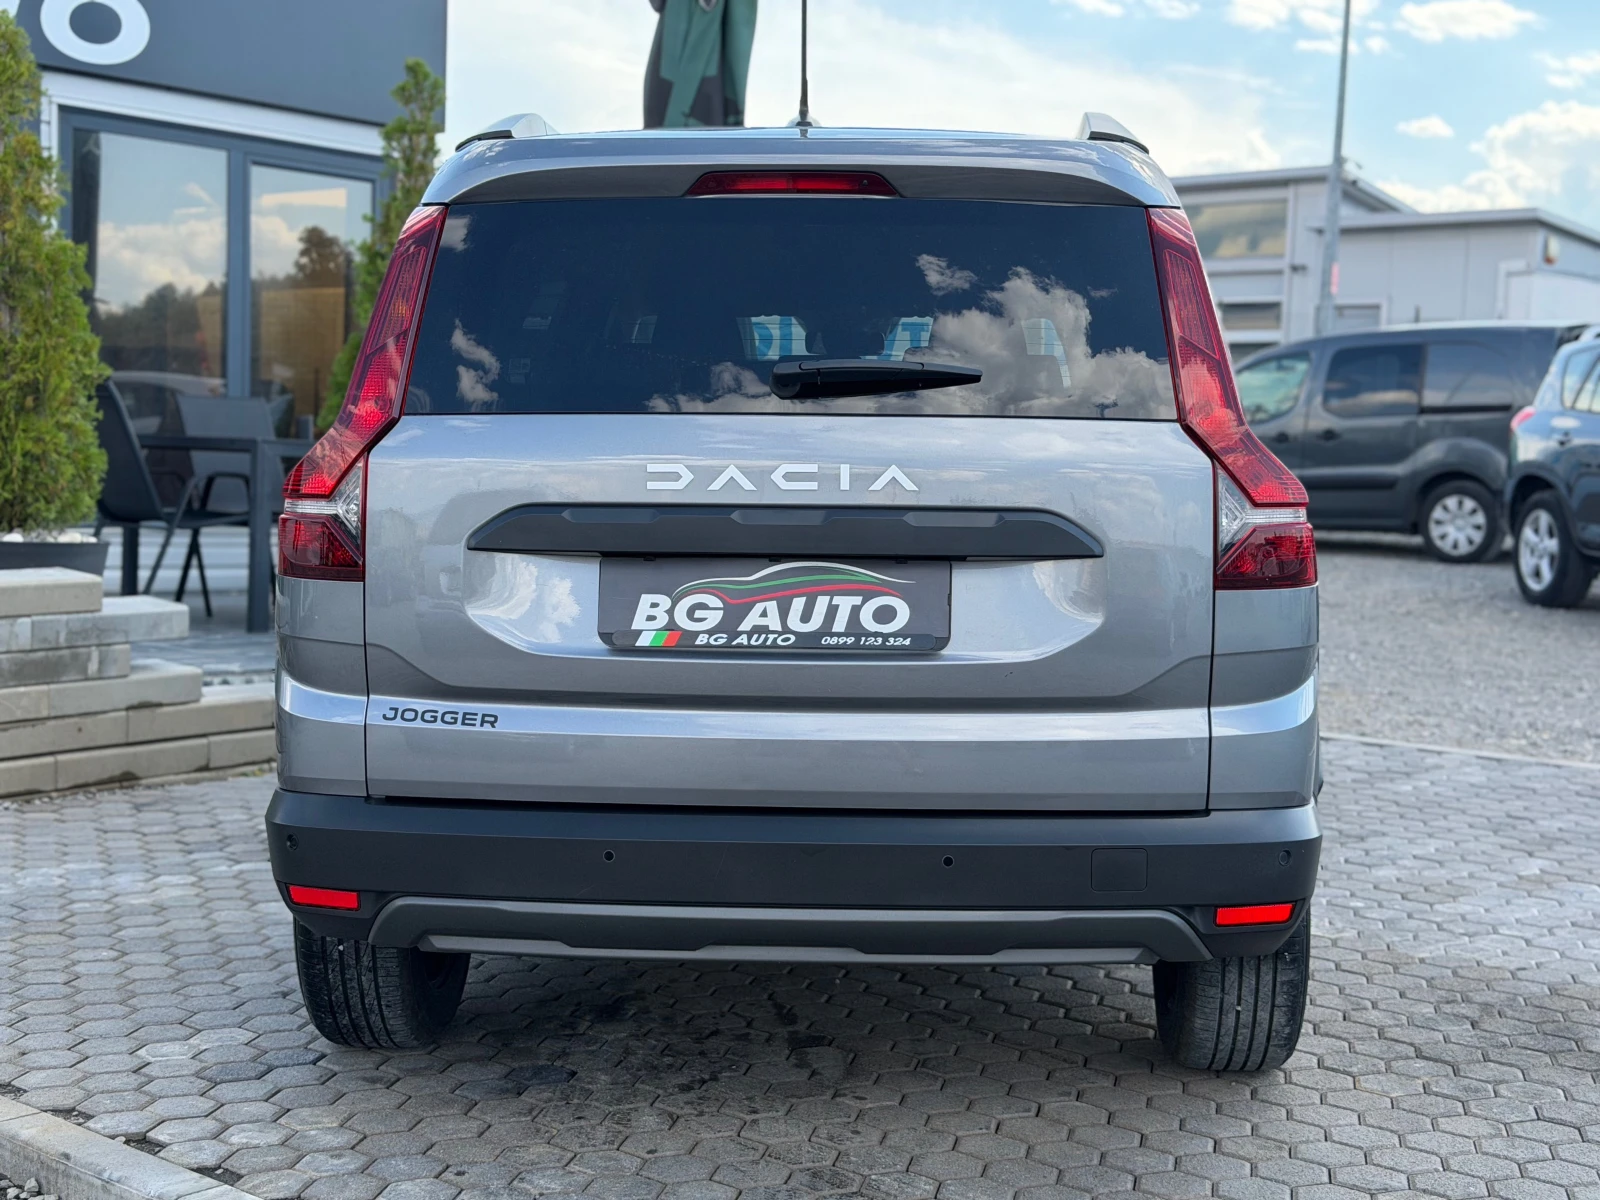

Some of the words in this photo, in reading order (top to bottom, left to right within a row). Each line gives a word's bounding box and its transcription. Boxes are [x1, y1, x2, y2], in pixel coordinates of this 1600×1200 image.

[0, 0, 151, 65] O
[646, 463, 919, 491] DACIA
[631, 594, 724, 631] BG
[737, 596, 911, 633] AUTO
[694, 633, 728, 645] BG
[731, 634, 796, 646] AUTO
[820, 636, 856, 645] 0899
[859, 636, 883, 646] 123
[885, 637, 912, 646] 324
[382, 706, 499, 729] JOGGER
